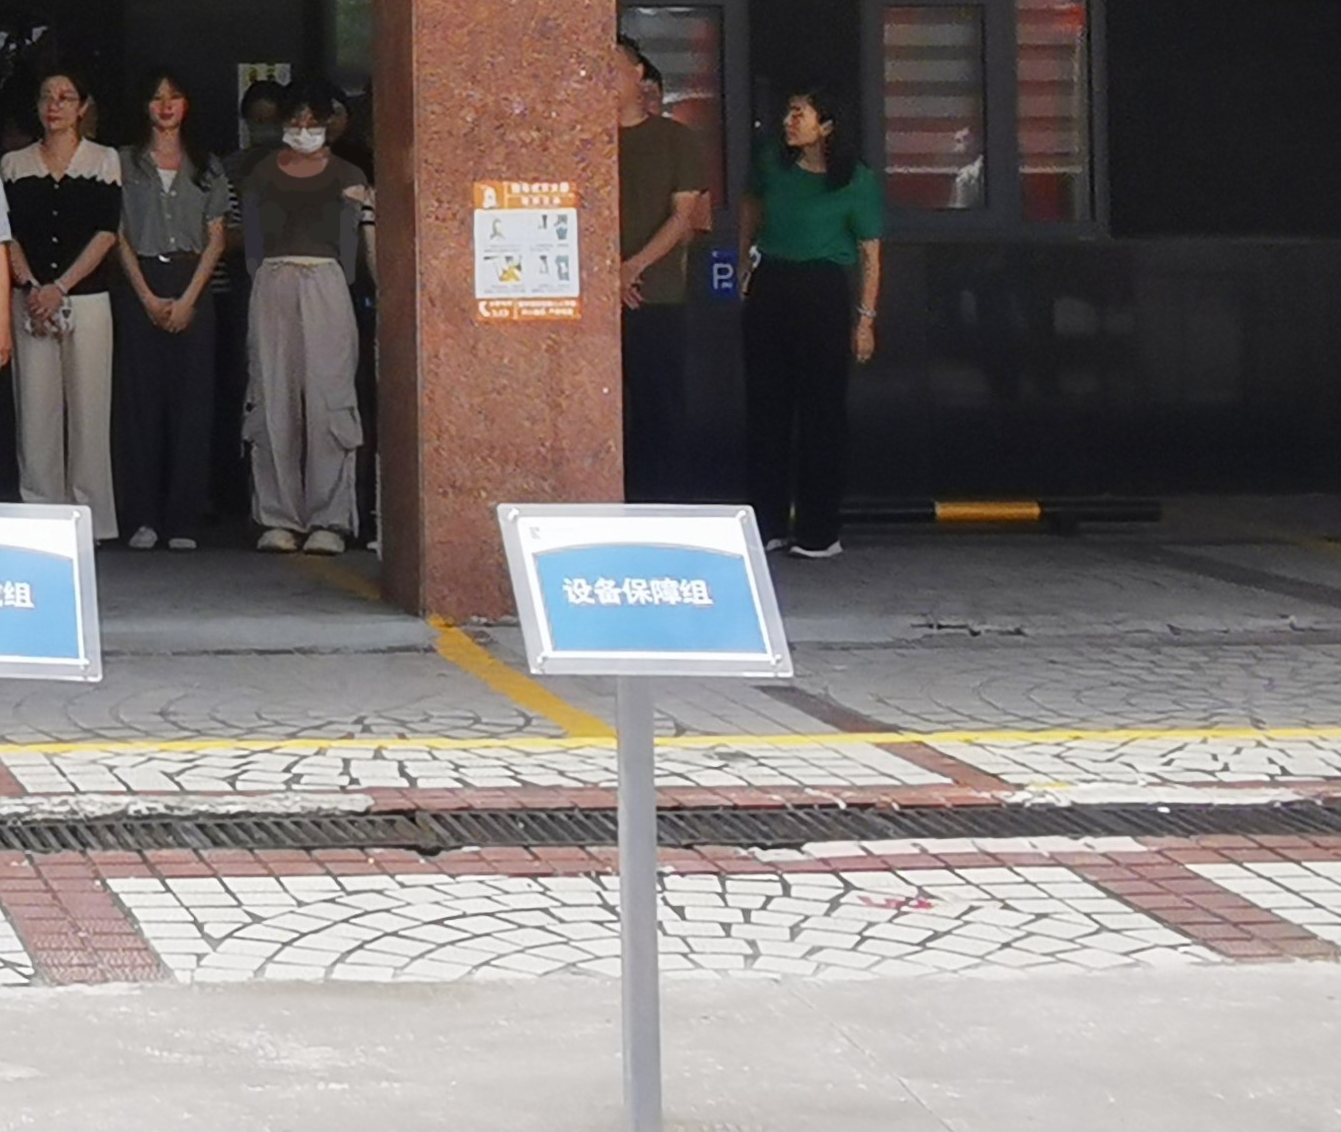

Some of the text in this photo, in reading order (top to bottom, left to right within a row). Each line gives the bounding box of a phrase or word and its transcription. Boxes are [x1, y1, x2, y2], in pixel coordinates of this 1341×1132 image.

[562, 576, 714, 606] 设备保障组
